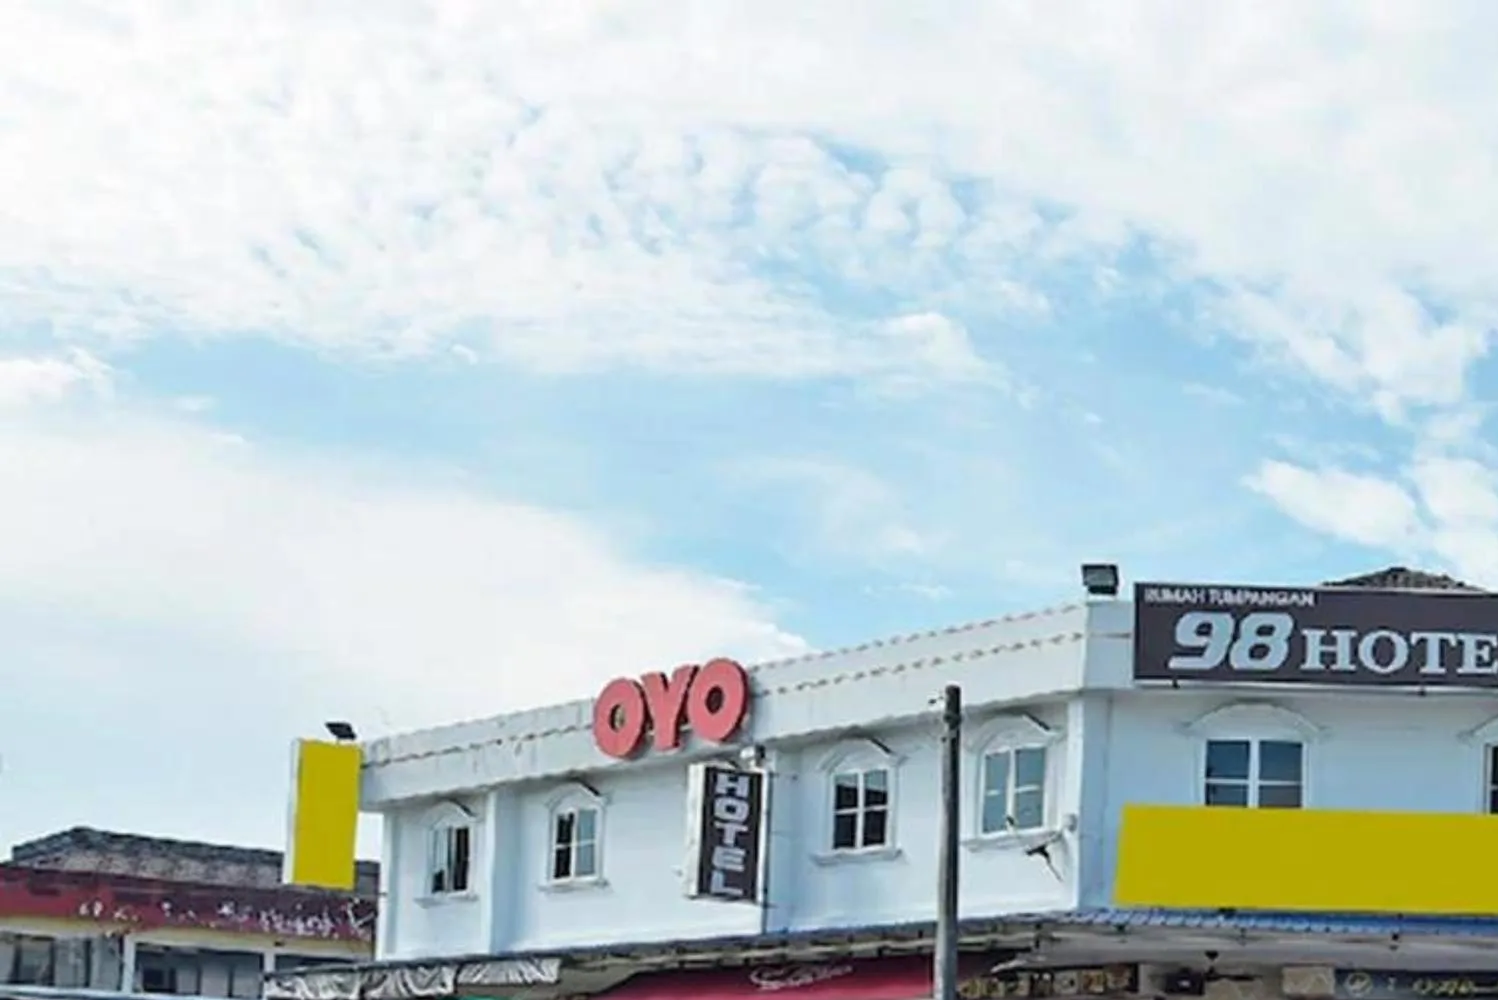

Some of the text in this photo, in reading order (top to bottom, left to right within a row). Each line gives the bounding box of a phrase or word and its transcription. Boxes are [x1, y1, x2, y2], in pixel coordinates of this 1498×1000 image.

[1168, 611, 1294, 671] 98
[593, 657, 750, 762] OYO
[709, 771, 751, 897] HOTEL
